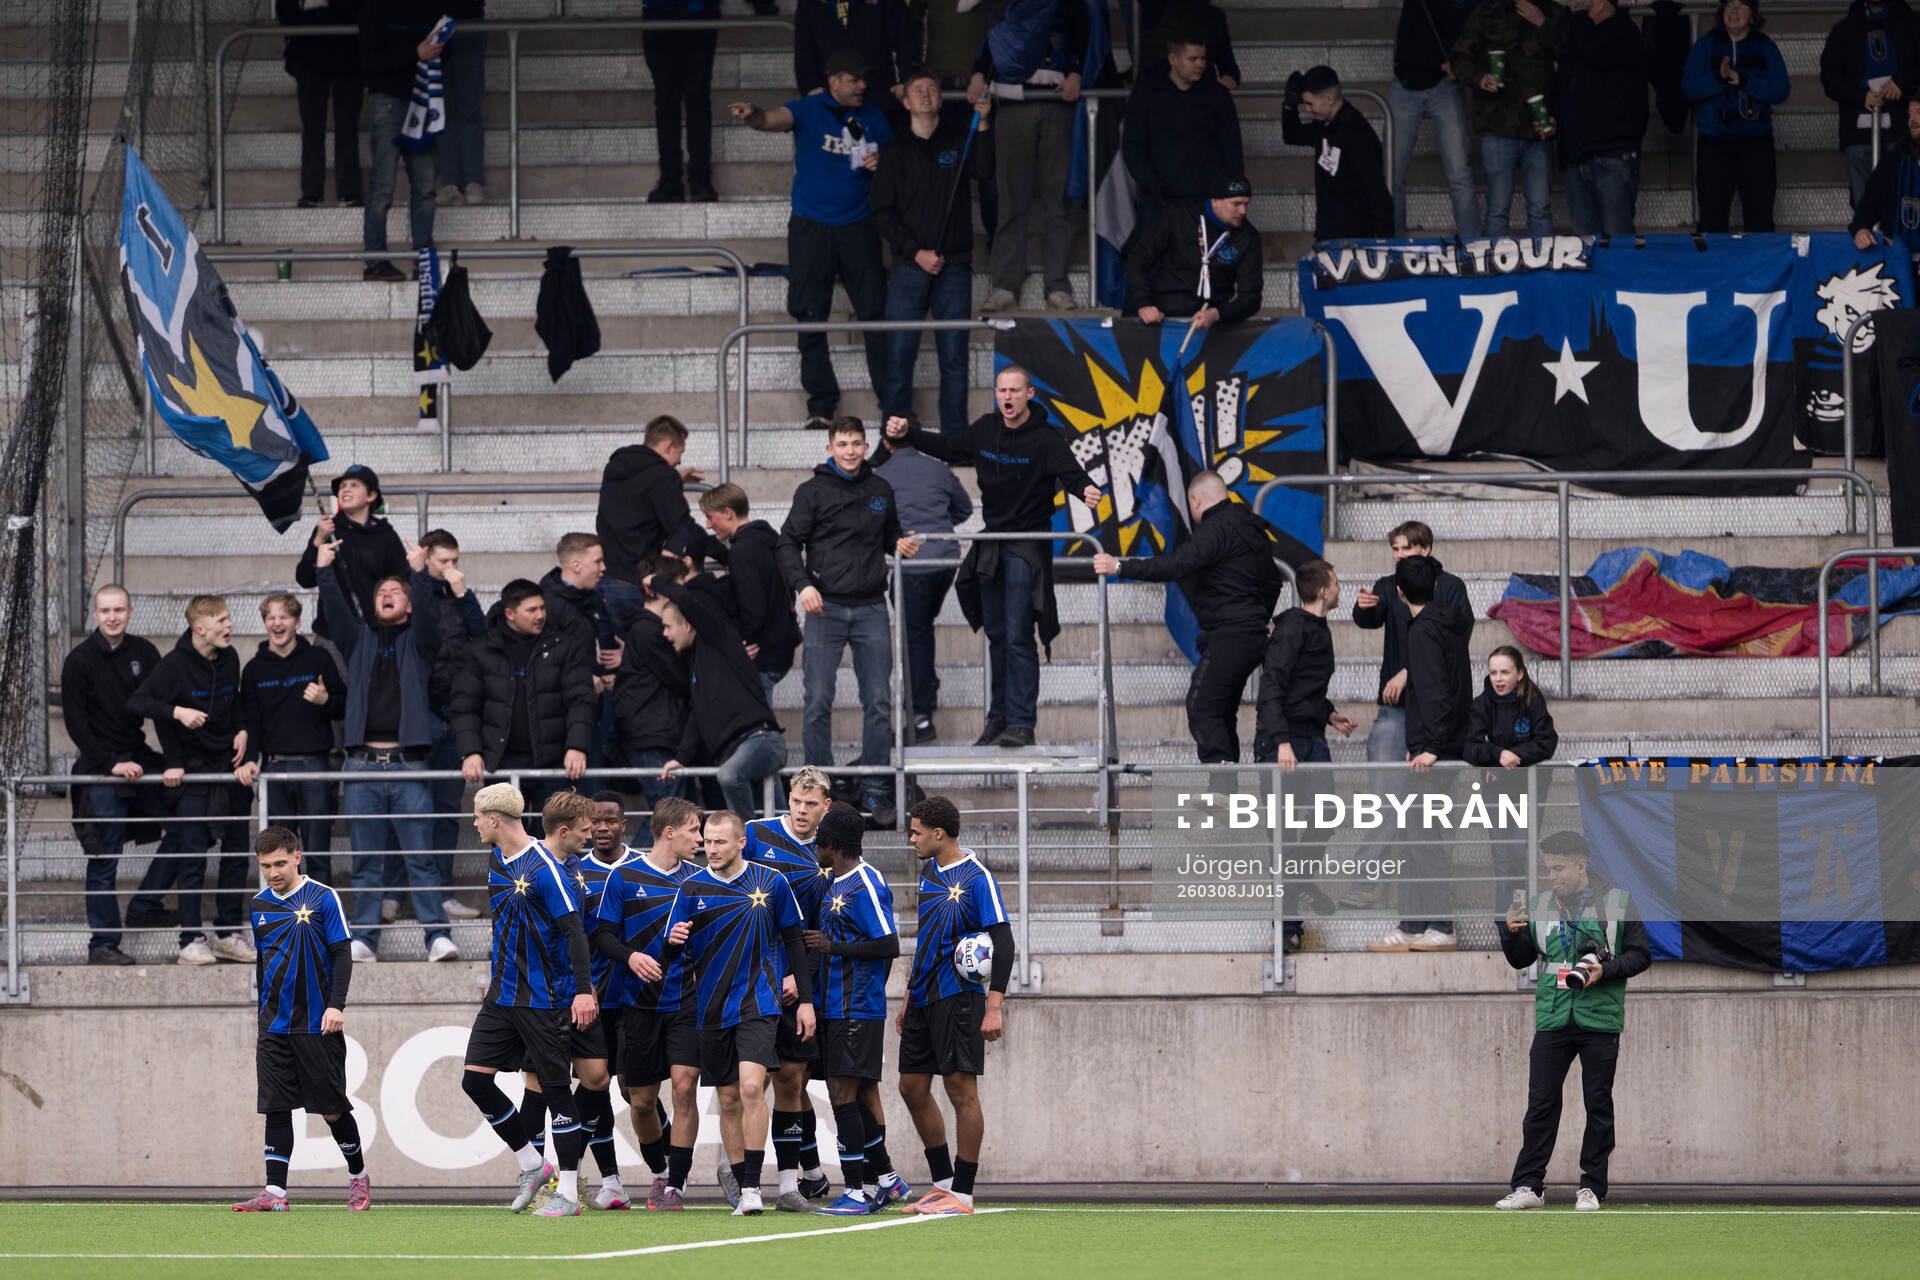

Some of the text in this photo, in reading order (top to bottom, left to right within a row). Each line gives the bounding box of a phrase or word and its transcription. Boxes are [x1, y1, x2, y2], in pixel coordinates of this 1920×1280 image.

[1317, 235, 1588, 281] VU ON TOUR
[1324, 290, 1518, 456] V
[1616, 290, 1787, 451] U
[1595, 761, 1876, 785] LEVE PALESTINA
[965, 941, 974, 968] SELECT
